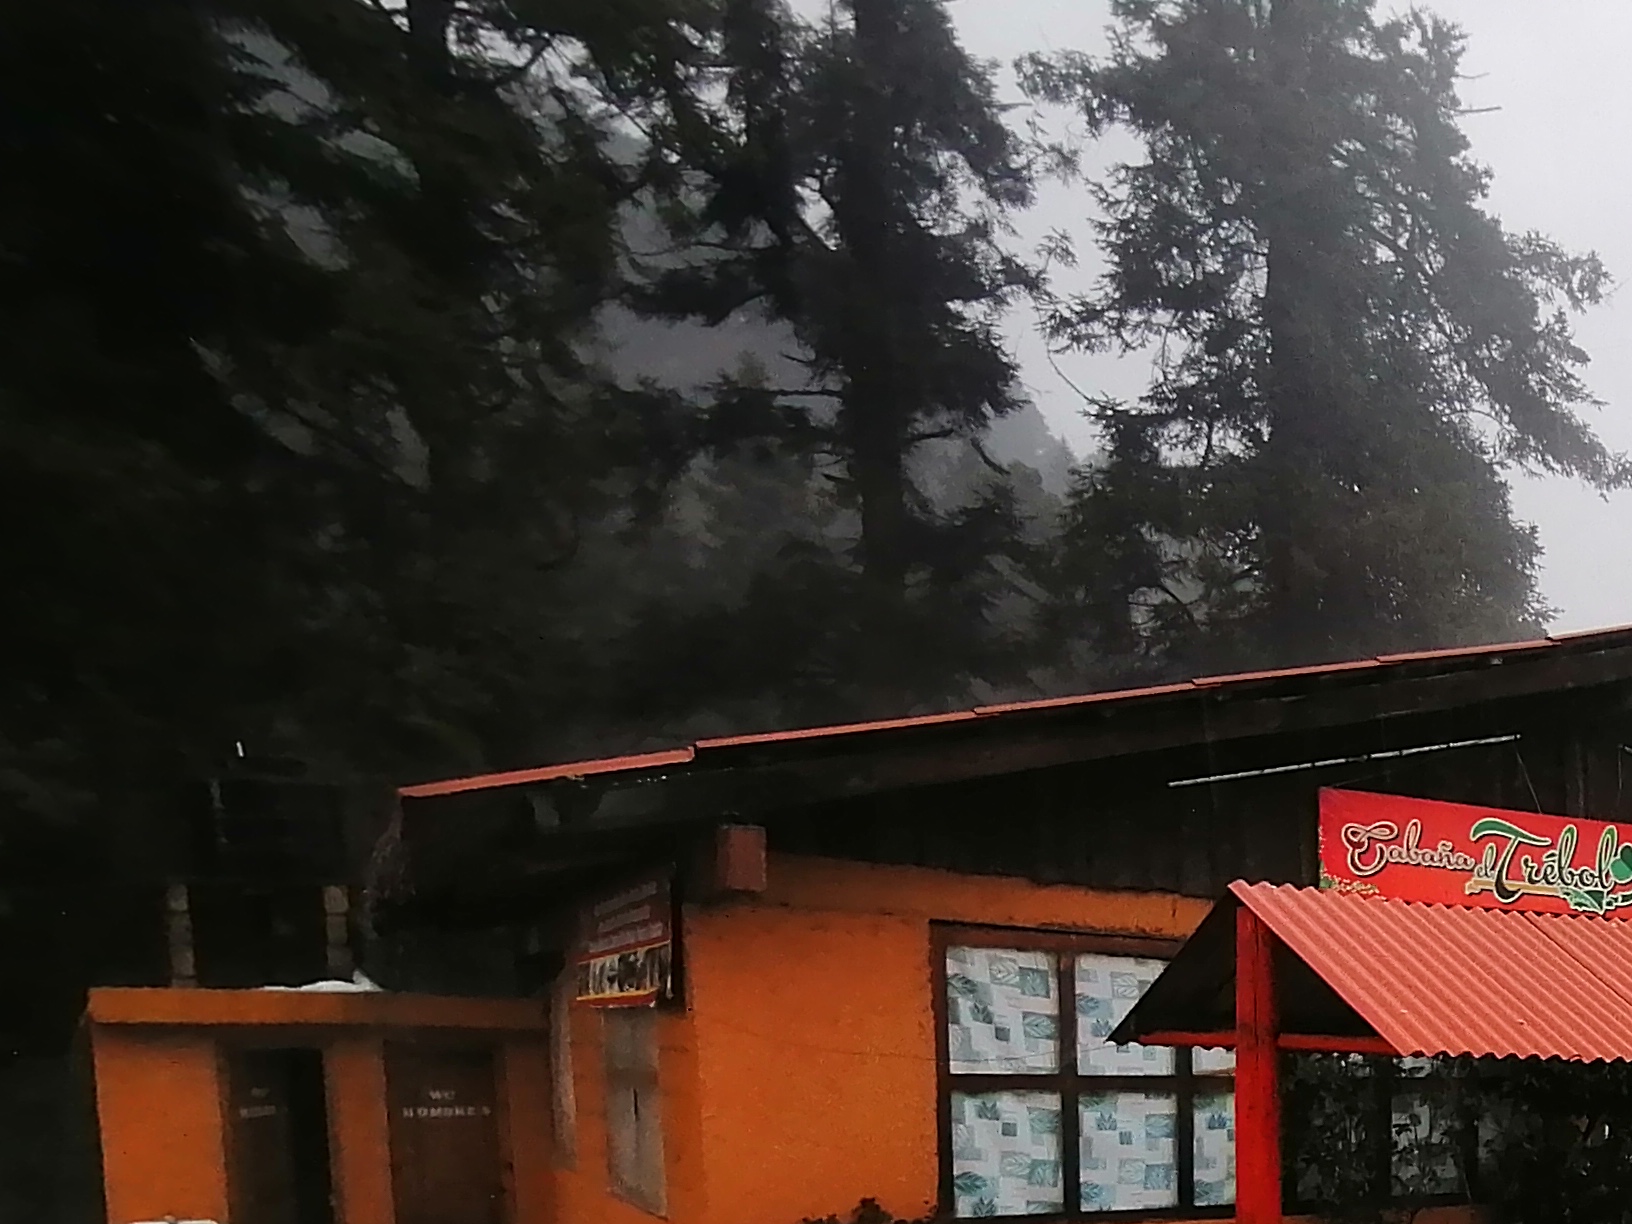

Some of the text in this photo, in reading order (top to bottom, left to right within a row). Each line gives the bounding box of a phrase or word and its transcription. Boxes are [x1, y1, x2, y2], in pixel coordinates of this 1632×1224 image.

[1341, 817, 1619, 904] Cabaña el Trébol
